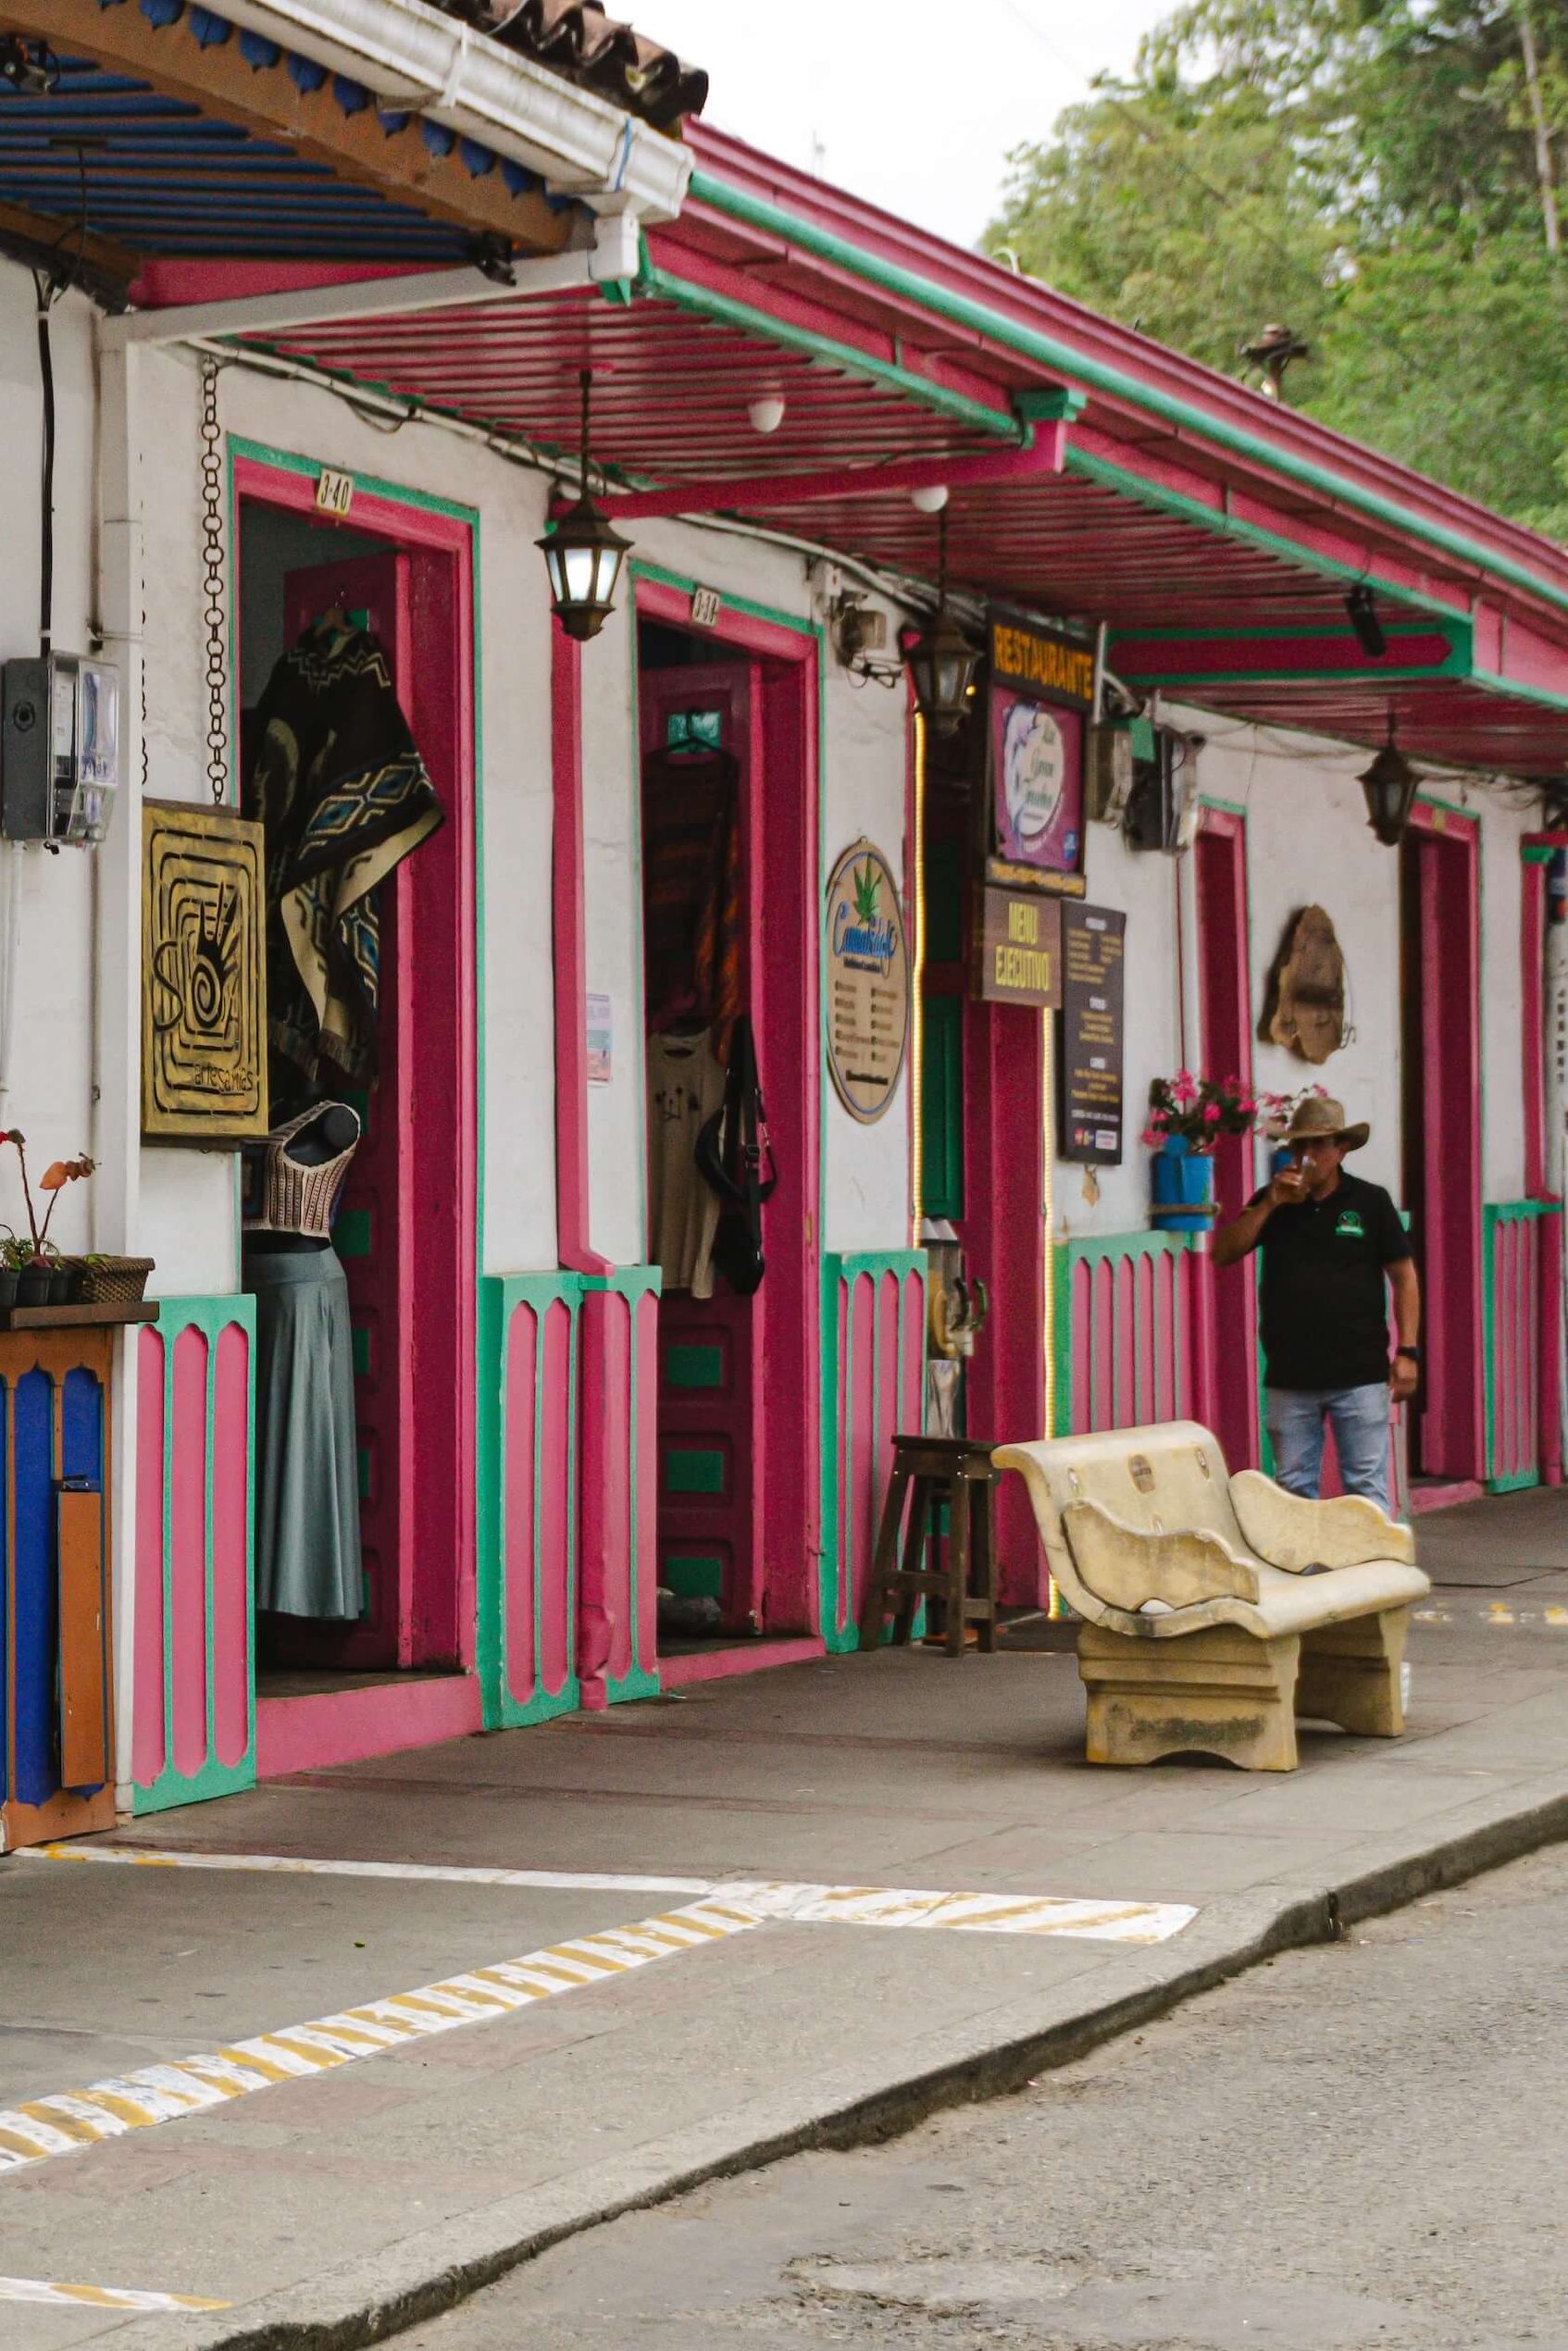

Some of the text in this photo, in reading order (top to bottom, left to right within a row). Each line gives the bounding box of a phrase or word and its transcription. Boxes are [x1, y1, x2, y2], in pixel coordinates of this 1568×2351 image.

[320, 474, 350, 511] 3-40
[992, 623, 1094, 702] RESTAURANTE
[1009, 902, 1039, 945] MENU
[995, 945, 1051, 992] EJECUTIVO
